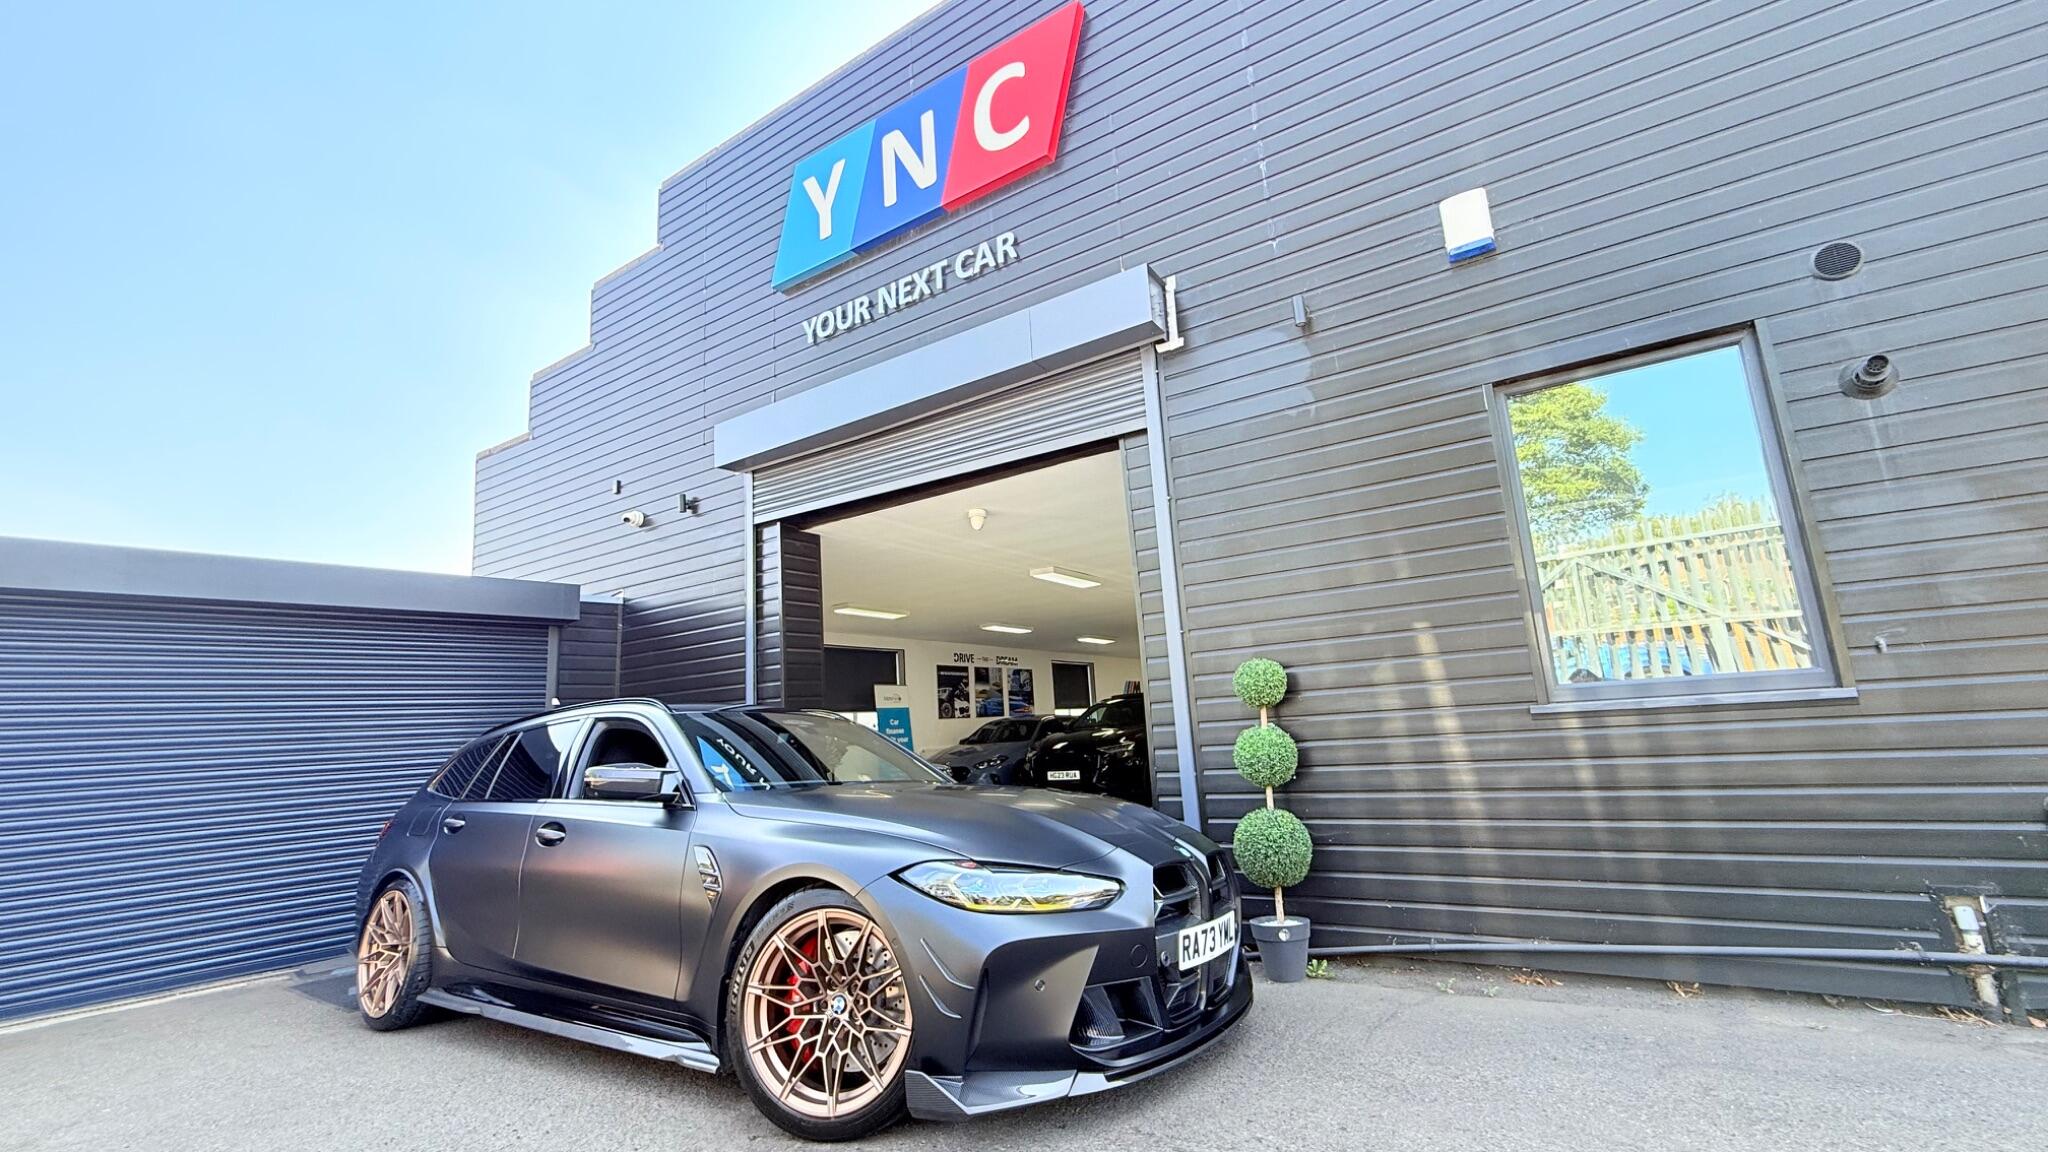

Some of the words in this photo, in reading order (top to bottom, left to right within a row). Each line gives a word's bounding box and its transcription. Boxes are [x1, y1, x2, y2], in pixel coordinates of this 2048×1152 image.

[802, 61, 1030, 241] YNC
[801, 295, 871, 344] YOUR
[878, 259, 948, 314] NEXT
[955, 231, 1018, 280] CAR
[953, 652, 975, 664] DRIVE
[1182, 926, 1216, 963] RA73
[1218, 917, 1233, 948] YML
